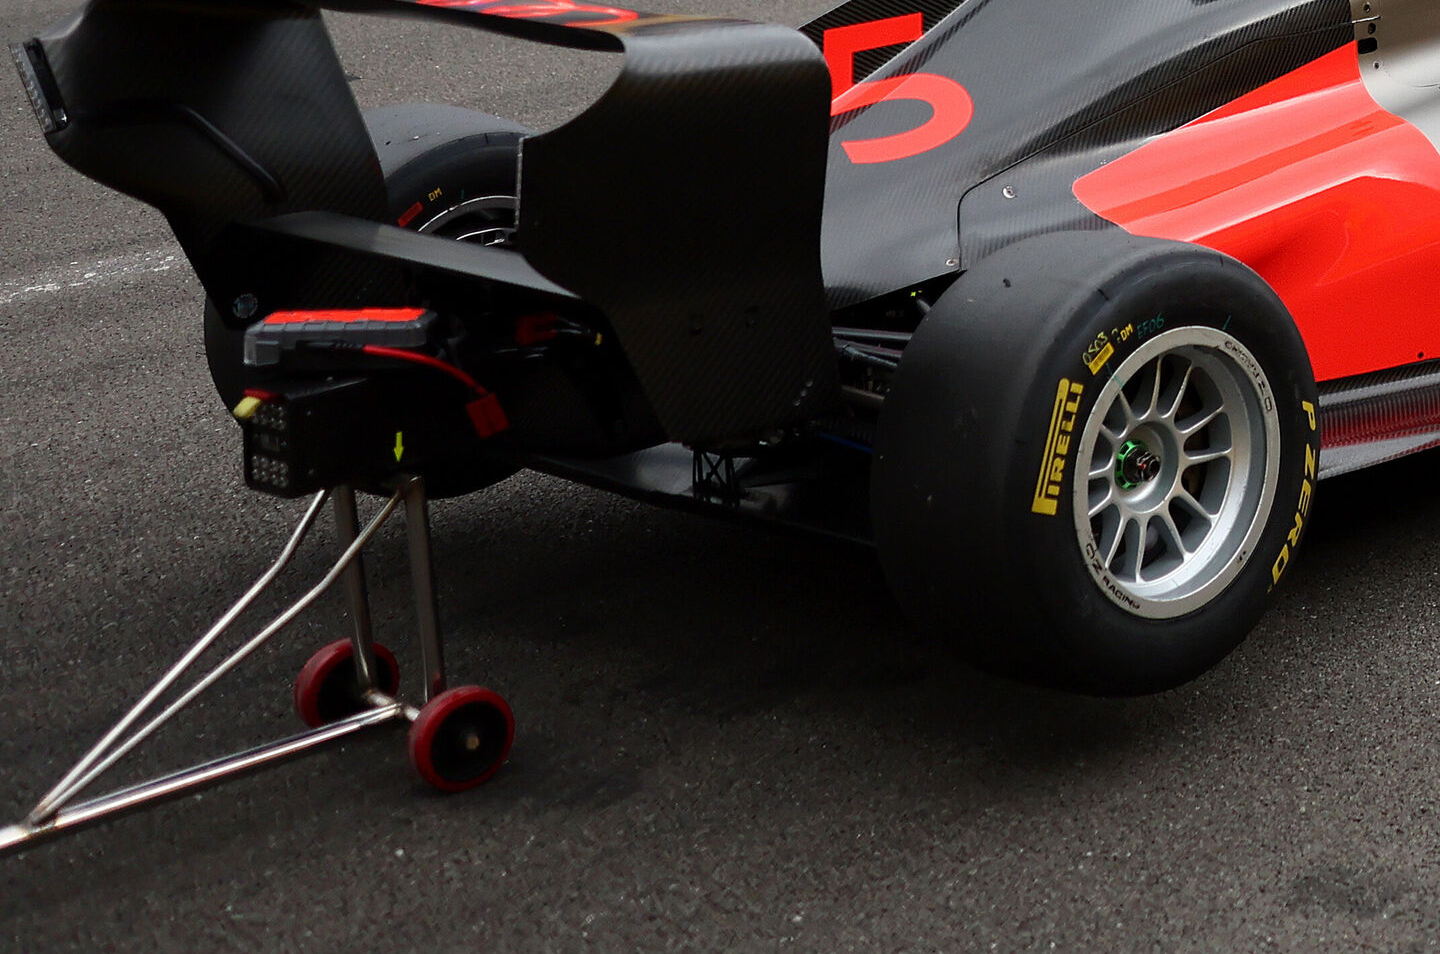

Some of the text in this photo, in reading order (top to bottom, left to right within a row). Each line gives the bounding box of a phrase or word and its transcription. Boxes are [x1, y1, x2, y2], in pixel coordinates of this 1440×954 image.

[822, 11, 975, 164] 5
[1031, 377, 1084, 516] PIRELLI
[1272, 400, 1316, 586] P ZERO
[1103, 575, 1141, 610] RACING
